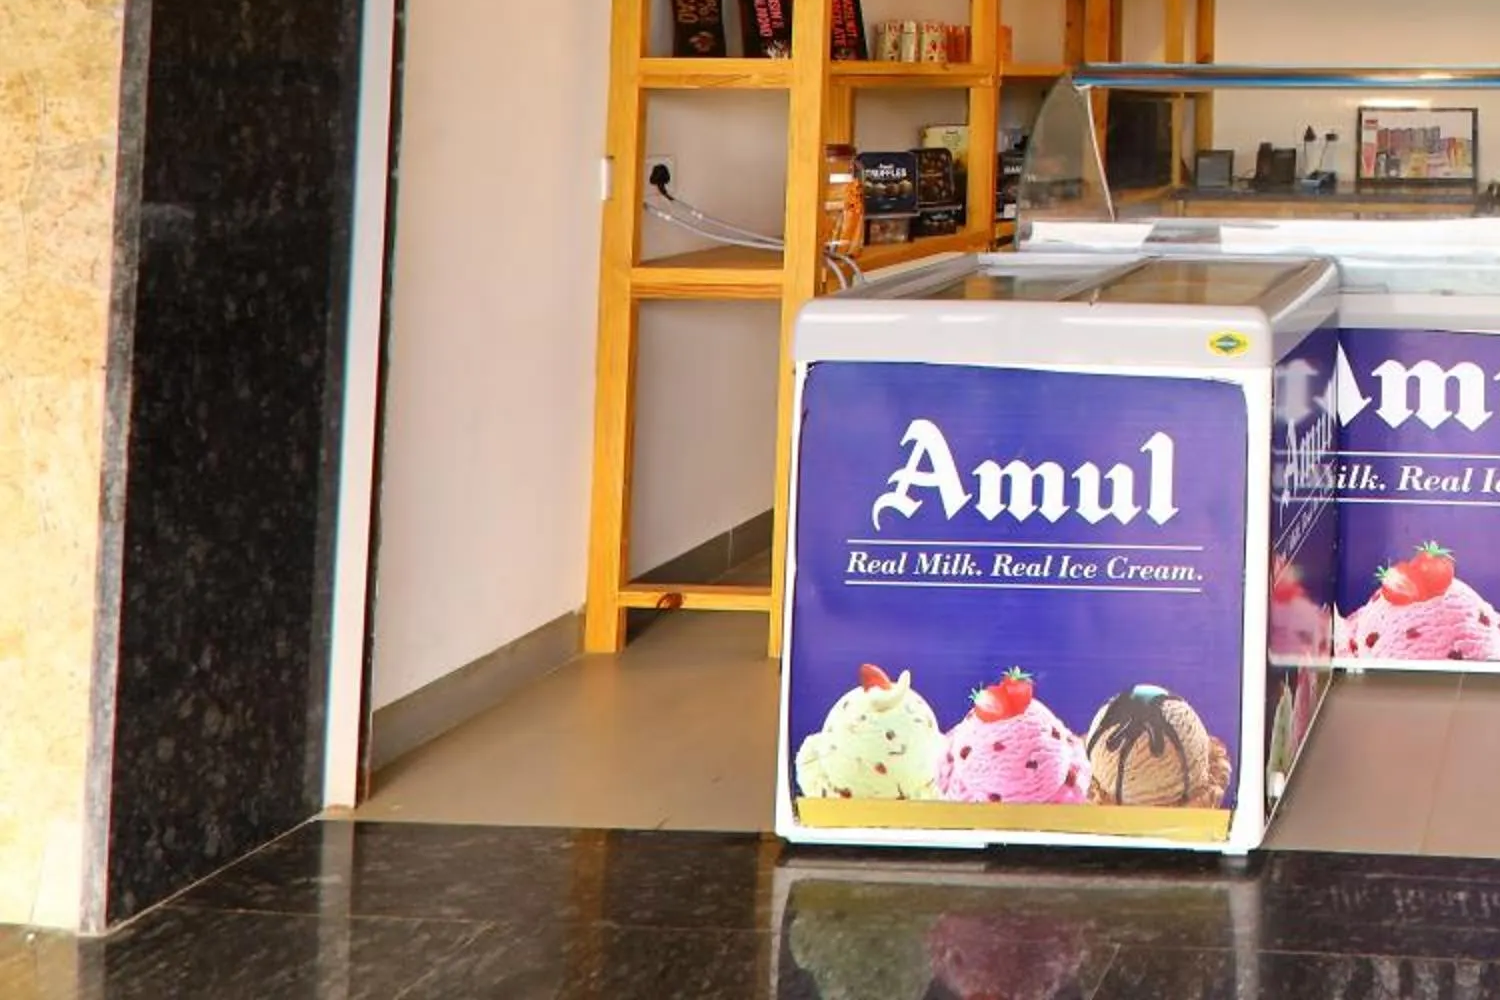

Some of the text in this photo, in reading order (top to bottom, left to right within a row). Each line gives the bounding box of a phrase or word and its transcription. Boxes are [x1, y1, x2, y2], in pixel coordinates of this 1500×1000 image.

[872, 418, 1179, 531] Amul
[1335, 465, 1386, 490] ilk.
[1399, 465, 1474, 493] Real
[846, 551, 1204, 582] Real Milk. Real Ice Cream.
